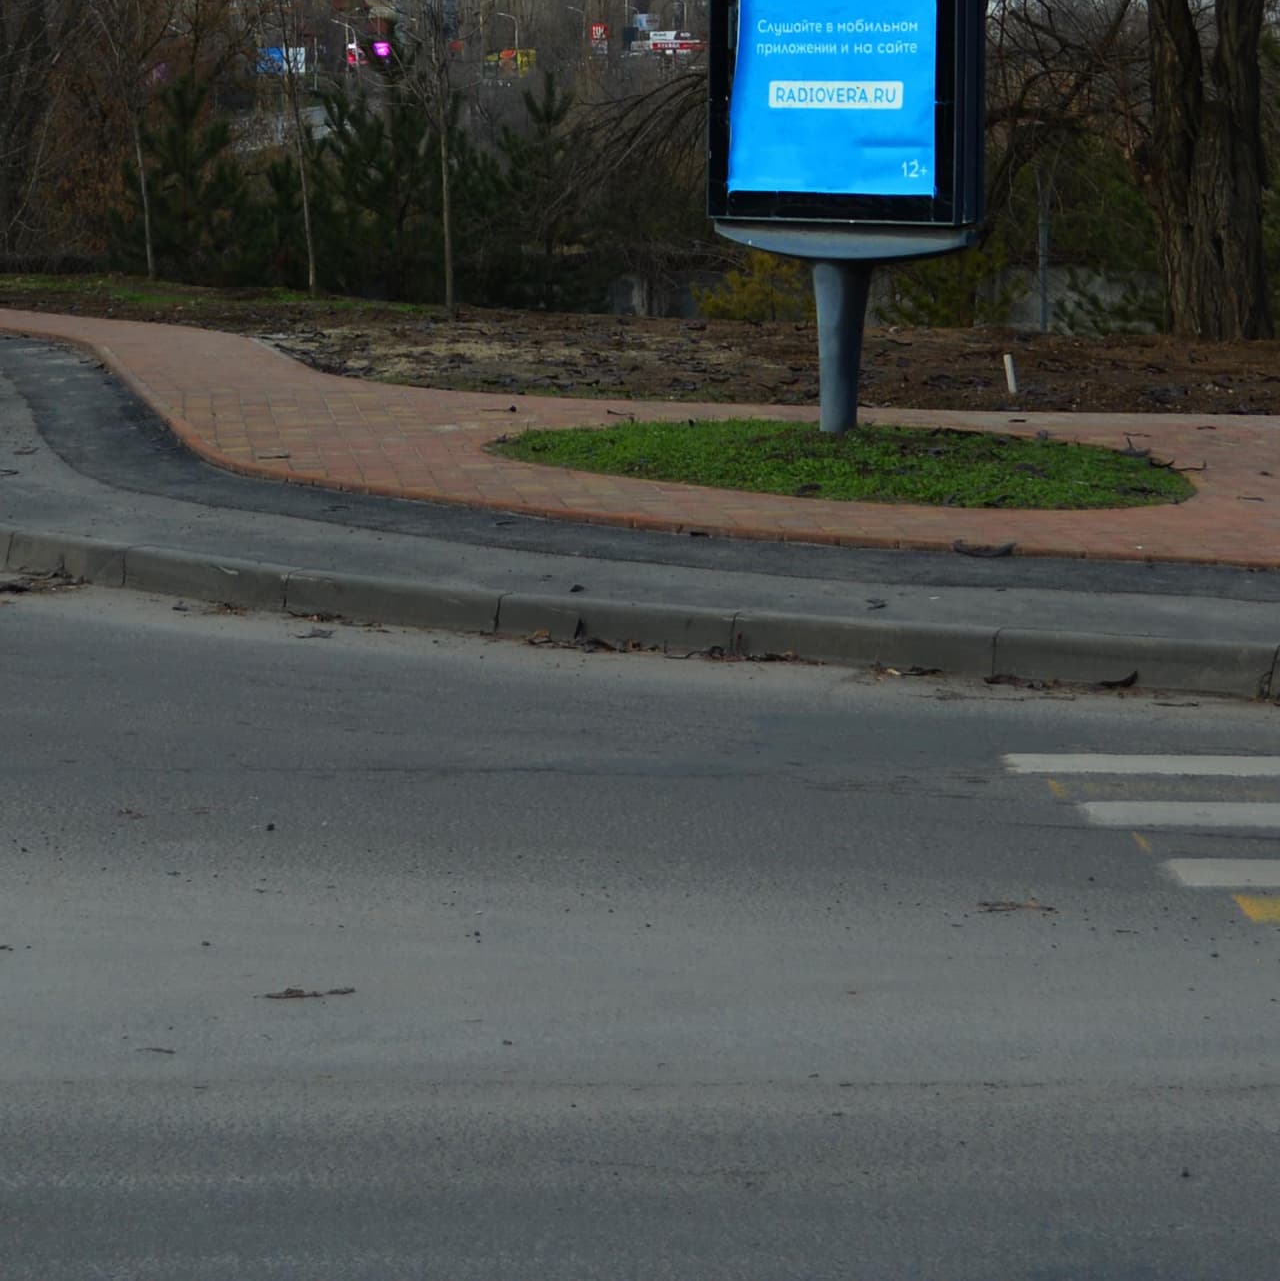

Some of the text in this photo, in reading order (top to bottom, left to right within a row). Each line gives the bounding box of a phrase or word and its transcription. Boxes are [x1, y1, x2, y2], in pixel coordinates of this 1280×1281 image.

[757, 19, 918, 36] Слушайте в мобильном
[756, 41, 918, 57] приложении и на сайте
[776, 87, 896, 104] RADIOVERA.RU
[901, 159, 928, 178] 12+
